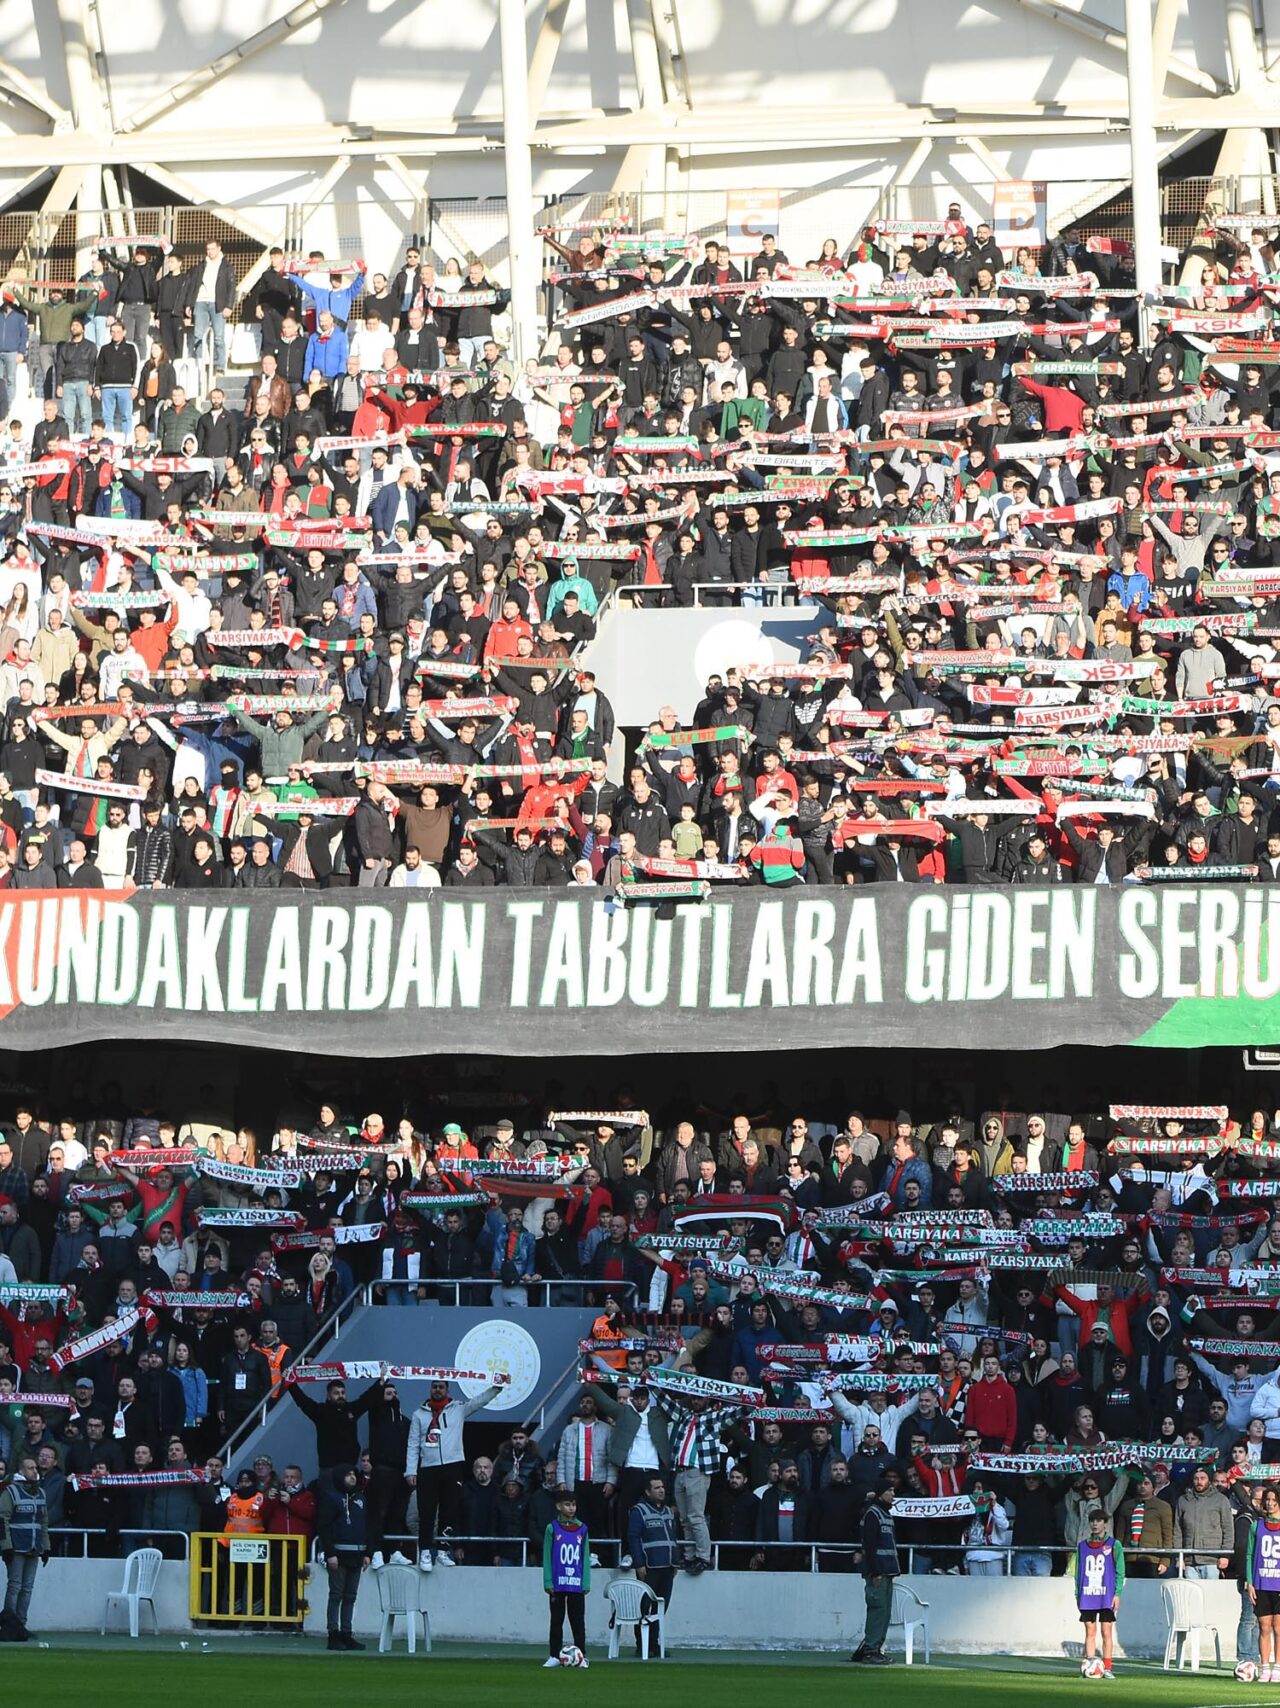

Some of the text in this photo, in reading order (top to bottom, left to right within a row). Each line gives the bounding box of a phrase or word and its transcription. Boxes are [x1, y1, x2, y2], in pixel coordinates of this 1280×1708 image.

[1195, 319, 1242, 331] KSK
[130, 458, 191, 472] KSK
[507, 896, 883, 1011] TABUTLARA
[1204, 1342, 1280, 1357] KARŞIYAKA
[560, 1543, 580, 1565] 004
[1263, 1558, 1278, 1568] TOP
[565, 1567, 575, 1577] TOP
